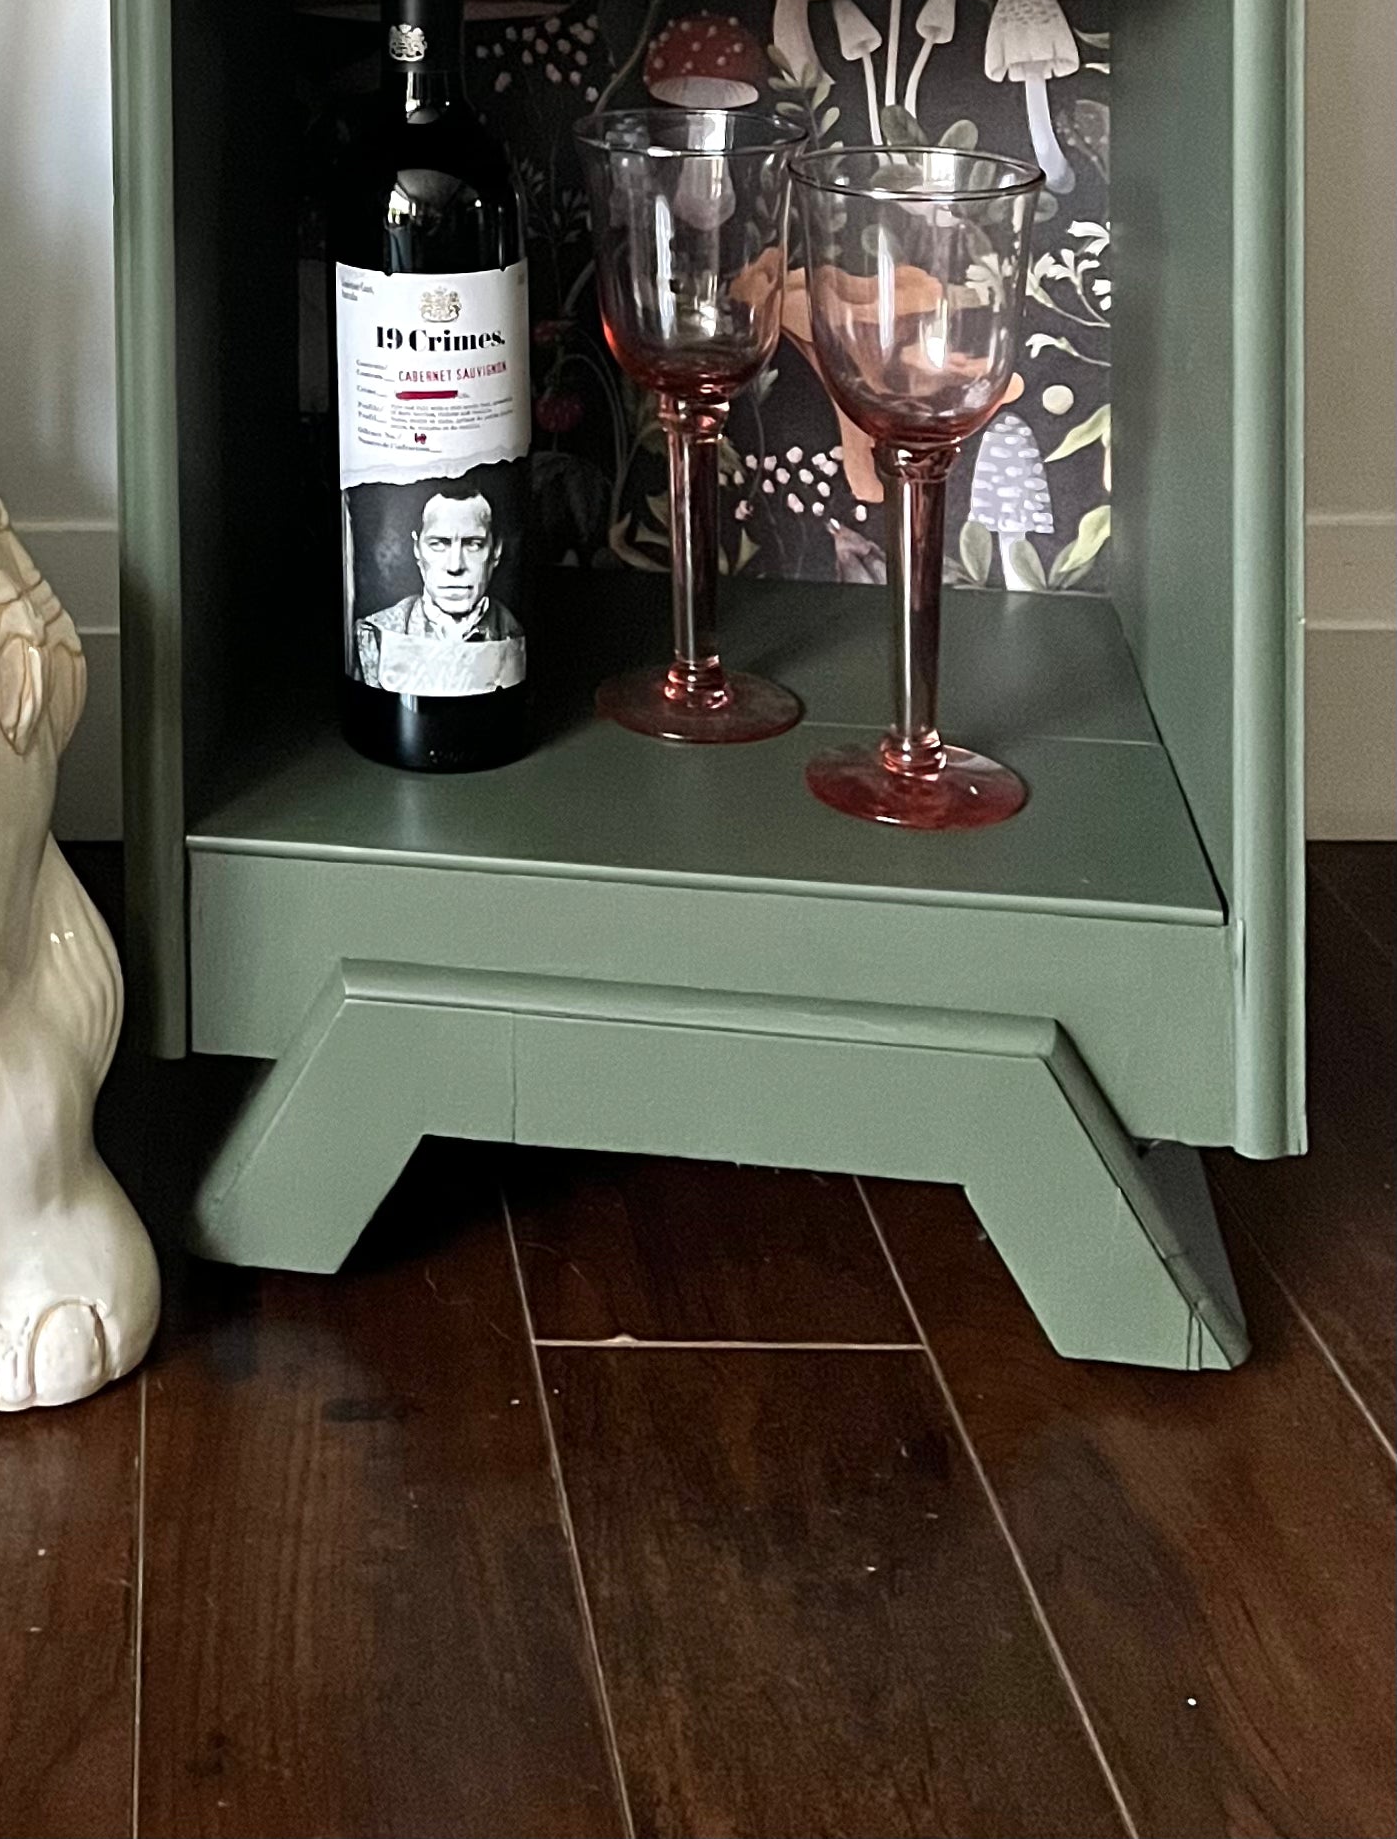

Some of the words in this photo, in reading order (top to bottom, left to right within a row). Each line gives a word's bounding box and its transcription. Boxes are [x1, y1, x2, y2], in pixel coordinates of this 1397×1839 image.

[377, 326, 403, 349] 19
[399, 370, 451, 383] CABERNET
[457, 362, 507, 380] SAUVIGNON
